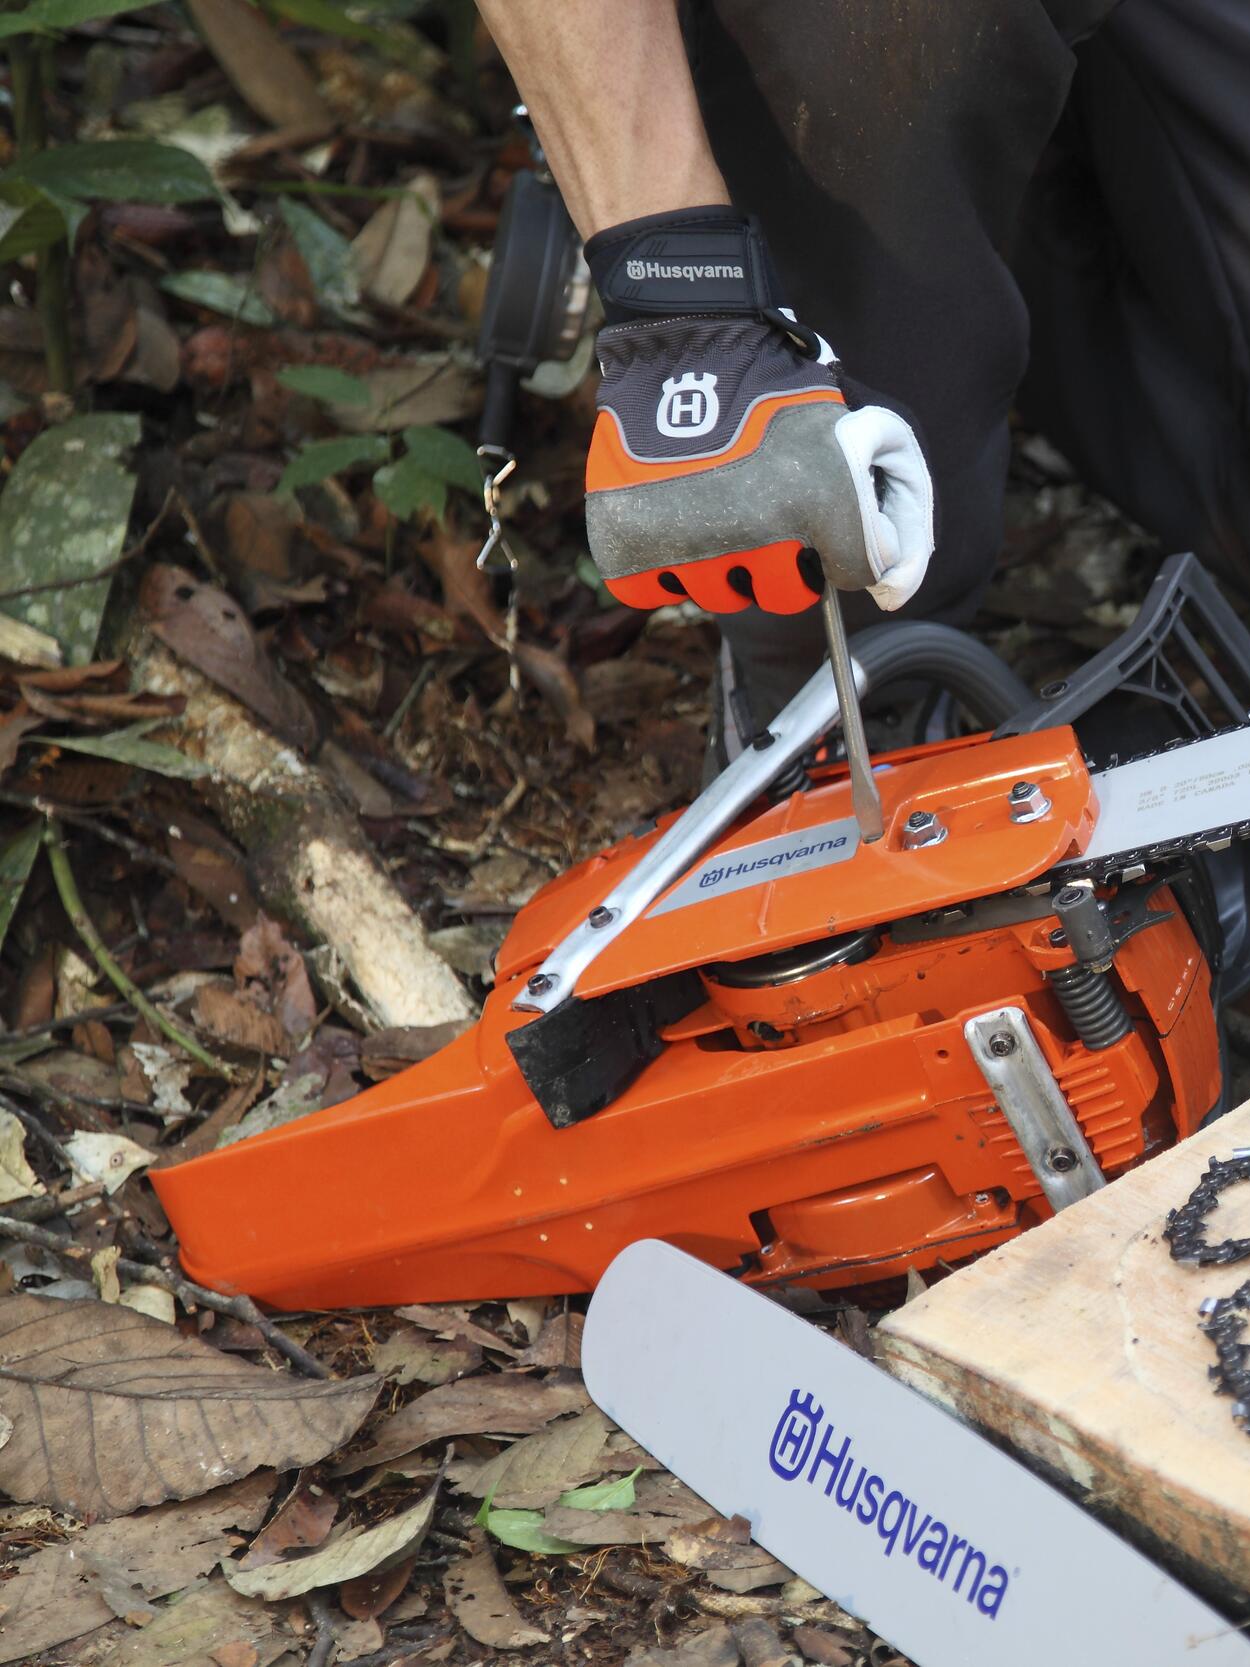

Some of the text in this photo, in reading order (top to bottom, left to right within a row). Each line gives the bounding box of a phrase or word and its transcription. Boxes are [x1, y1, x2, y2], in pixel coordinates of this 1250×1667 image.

[646, 262, 744, 281] Husqvarna
[671, 392, 702, 425] H
[724, 836, 848, 879] Husqvarna
[806, 1423, 1009, 1621] Husqvarna
